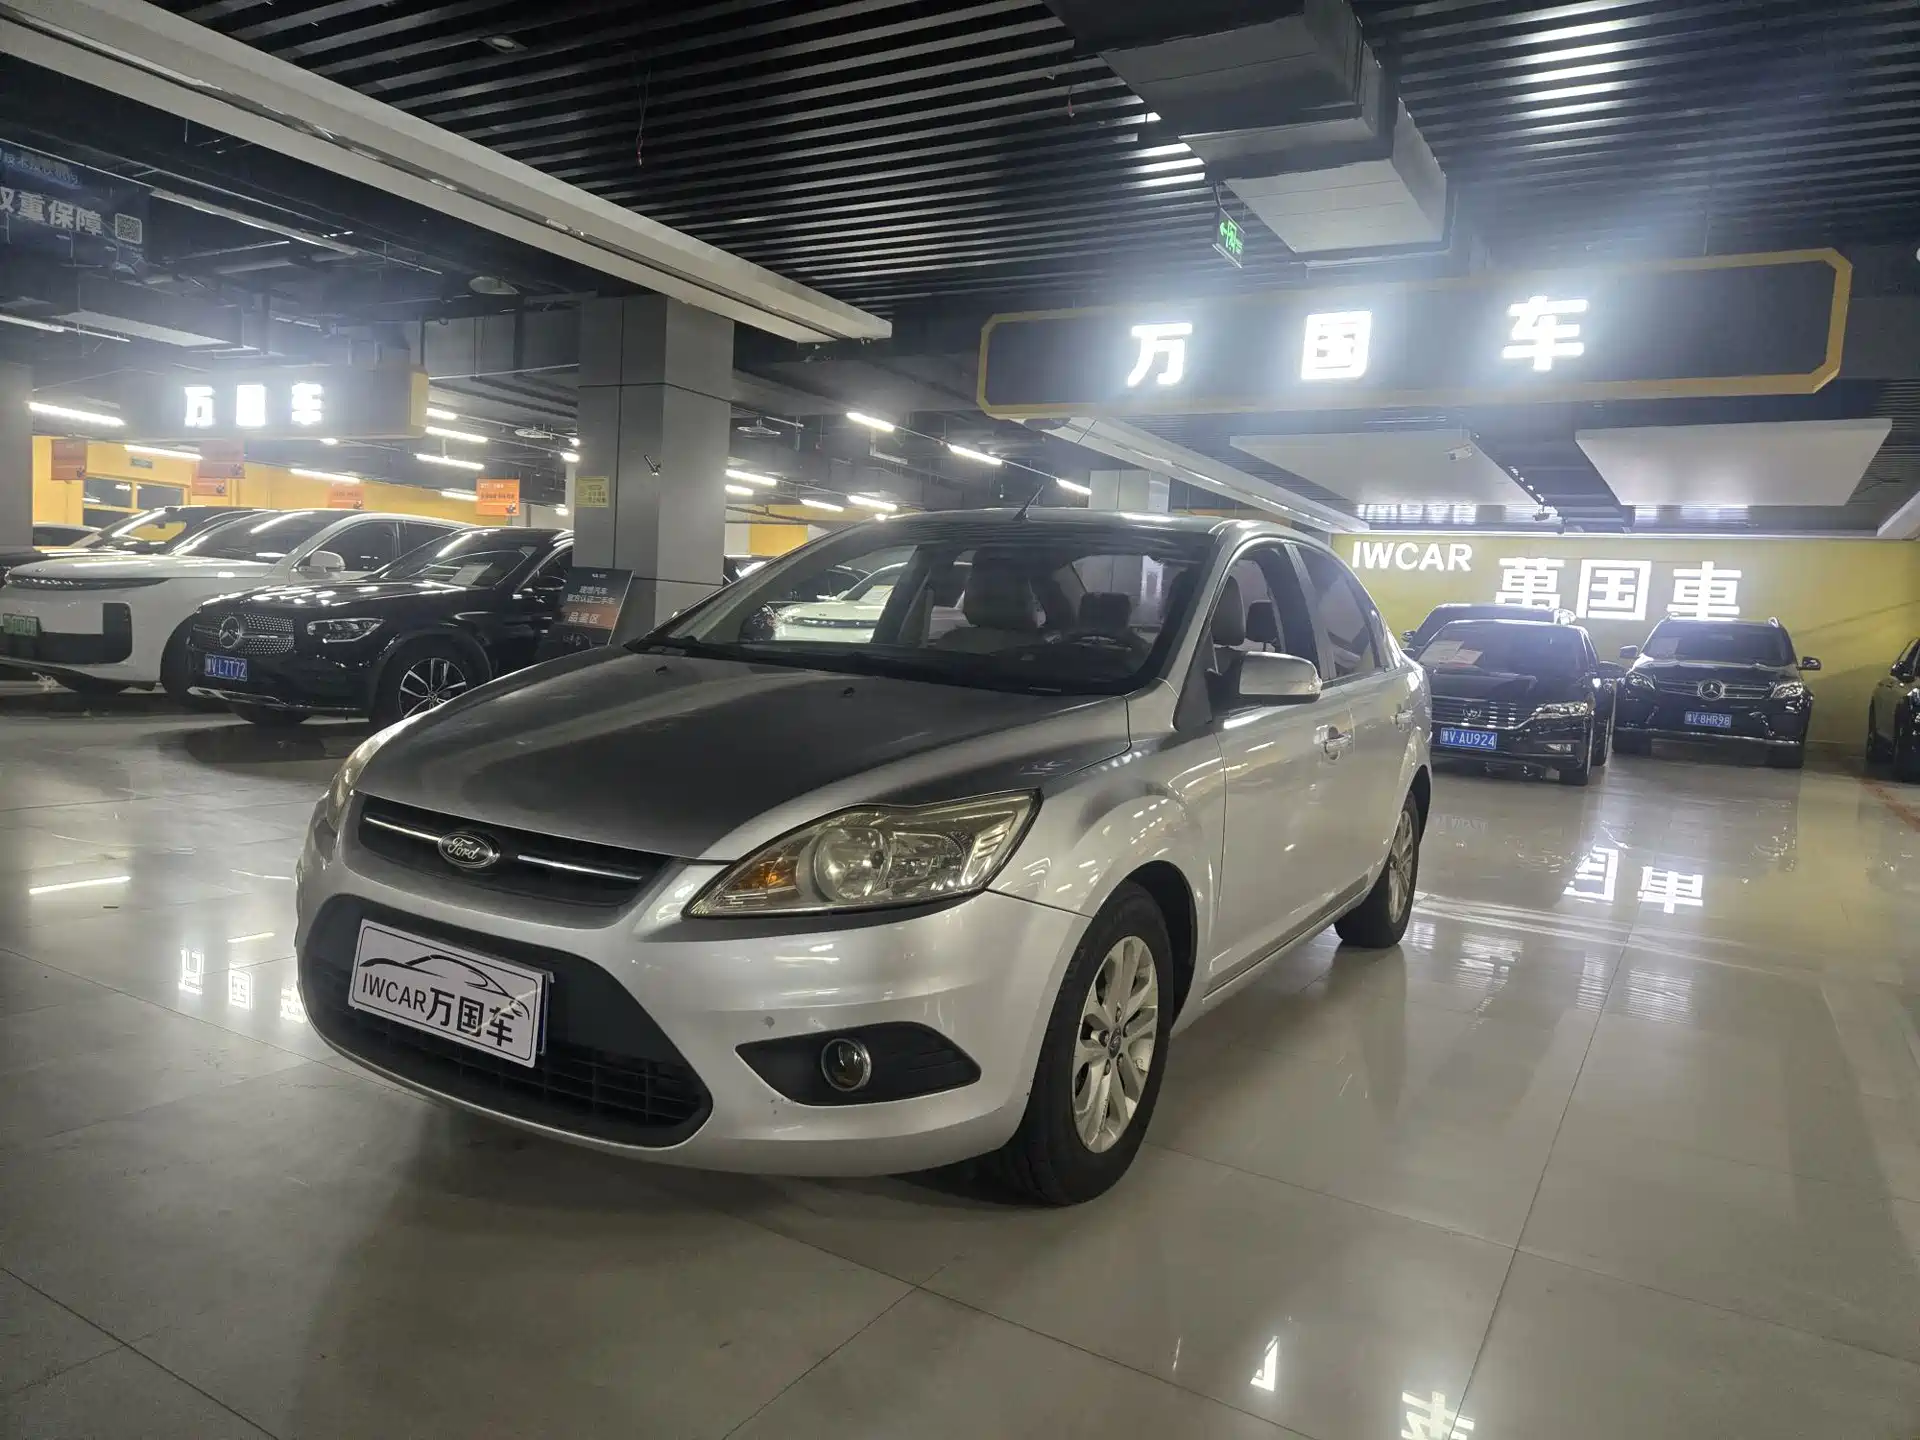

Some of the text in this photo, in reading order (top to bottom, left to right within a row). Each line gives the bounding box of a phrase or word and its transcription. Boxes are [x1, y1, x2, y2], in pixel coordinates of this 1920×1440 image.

[1126, 294, 1588, 387] 万国车
[1351, 541, 1473, 572] IWCAR
[447, 836, 481, 860] Ford
